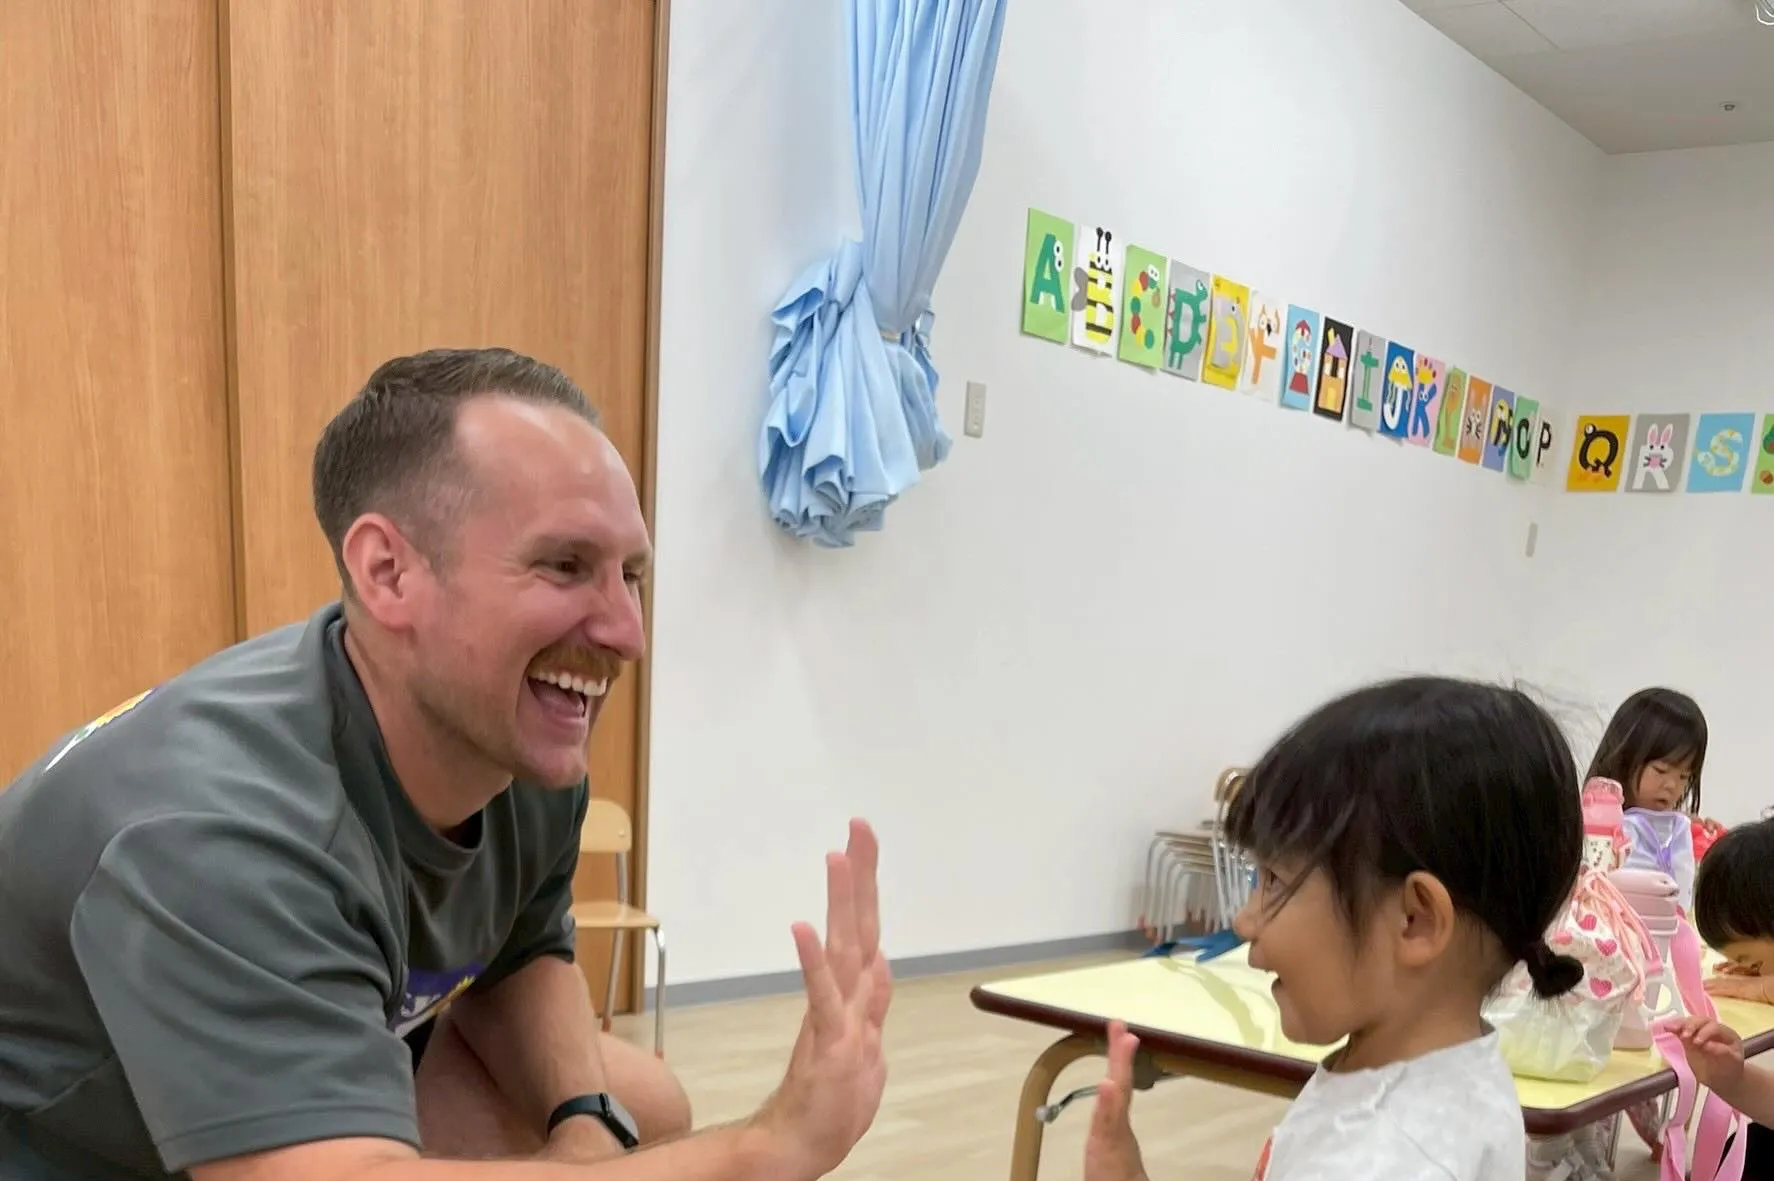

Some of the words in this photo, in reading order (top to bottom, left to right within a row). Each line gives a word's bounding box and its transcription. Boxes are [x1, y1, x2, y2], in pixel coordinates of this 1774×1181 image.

[1030, 233, 1065, 314] A
[1168, 281, 1208, 370] D
[1412, 379, 1438, 439] K
[1579, 424, 1613, 478] Q
[1632, 437, 1674, 490] R
[1697, 428, 1744, 477] S
